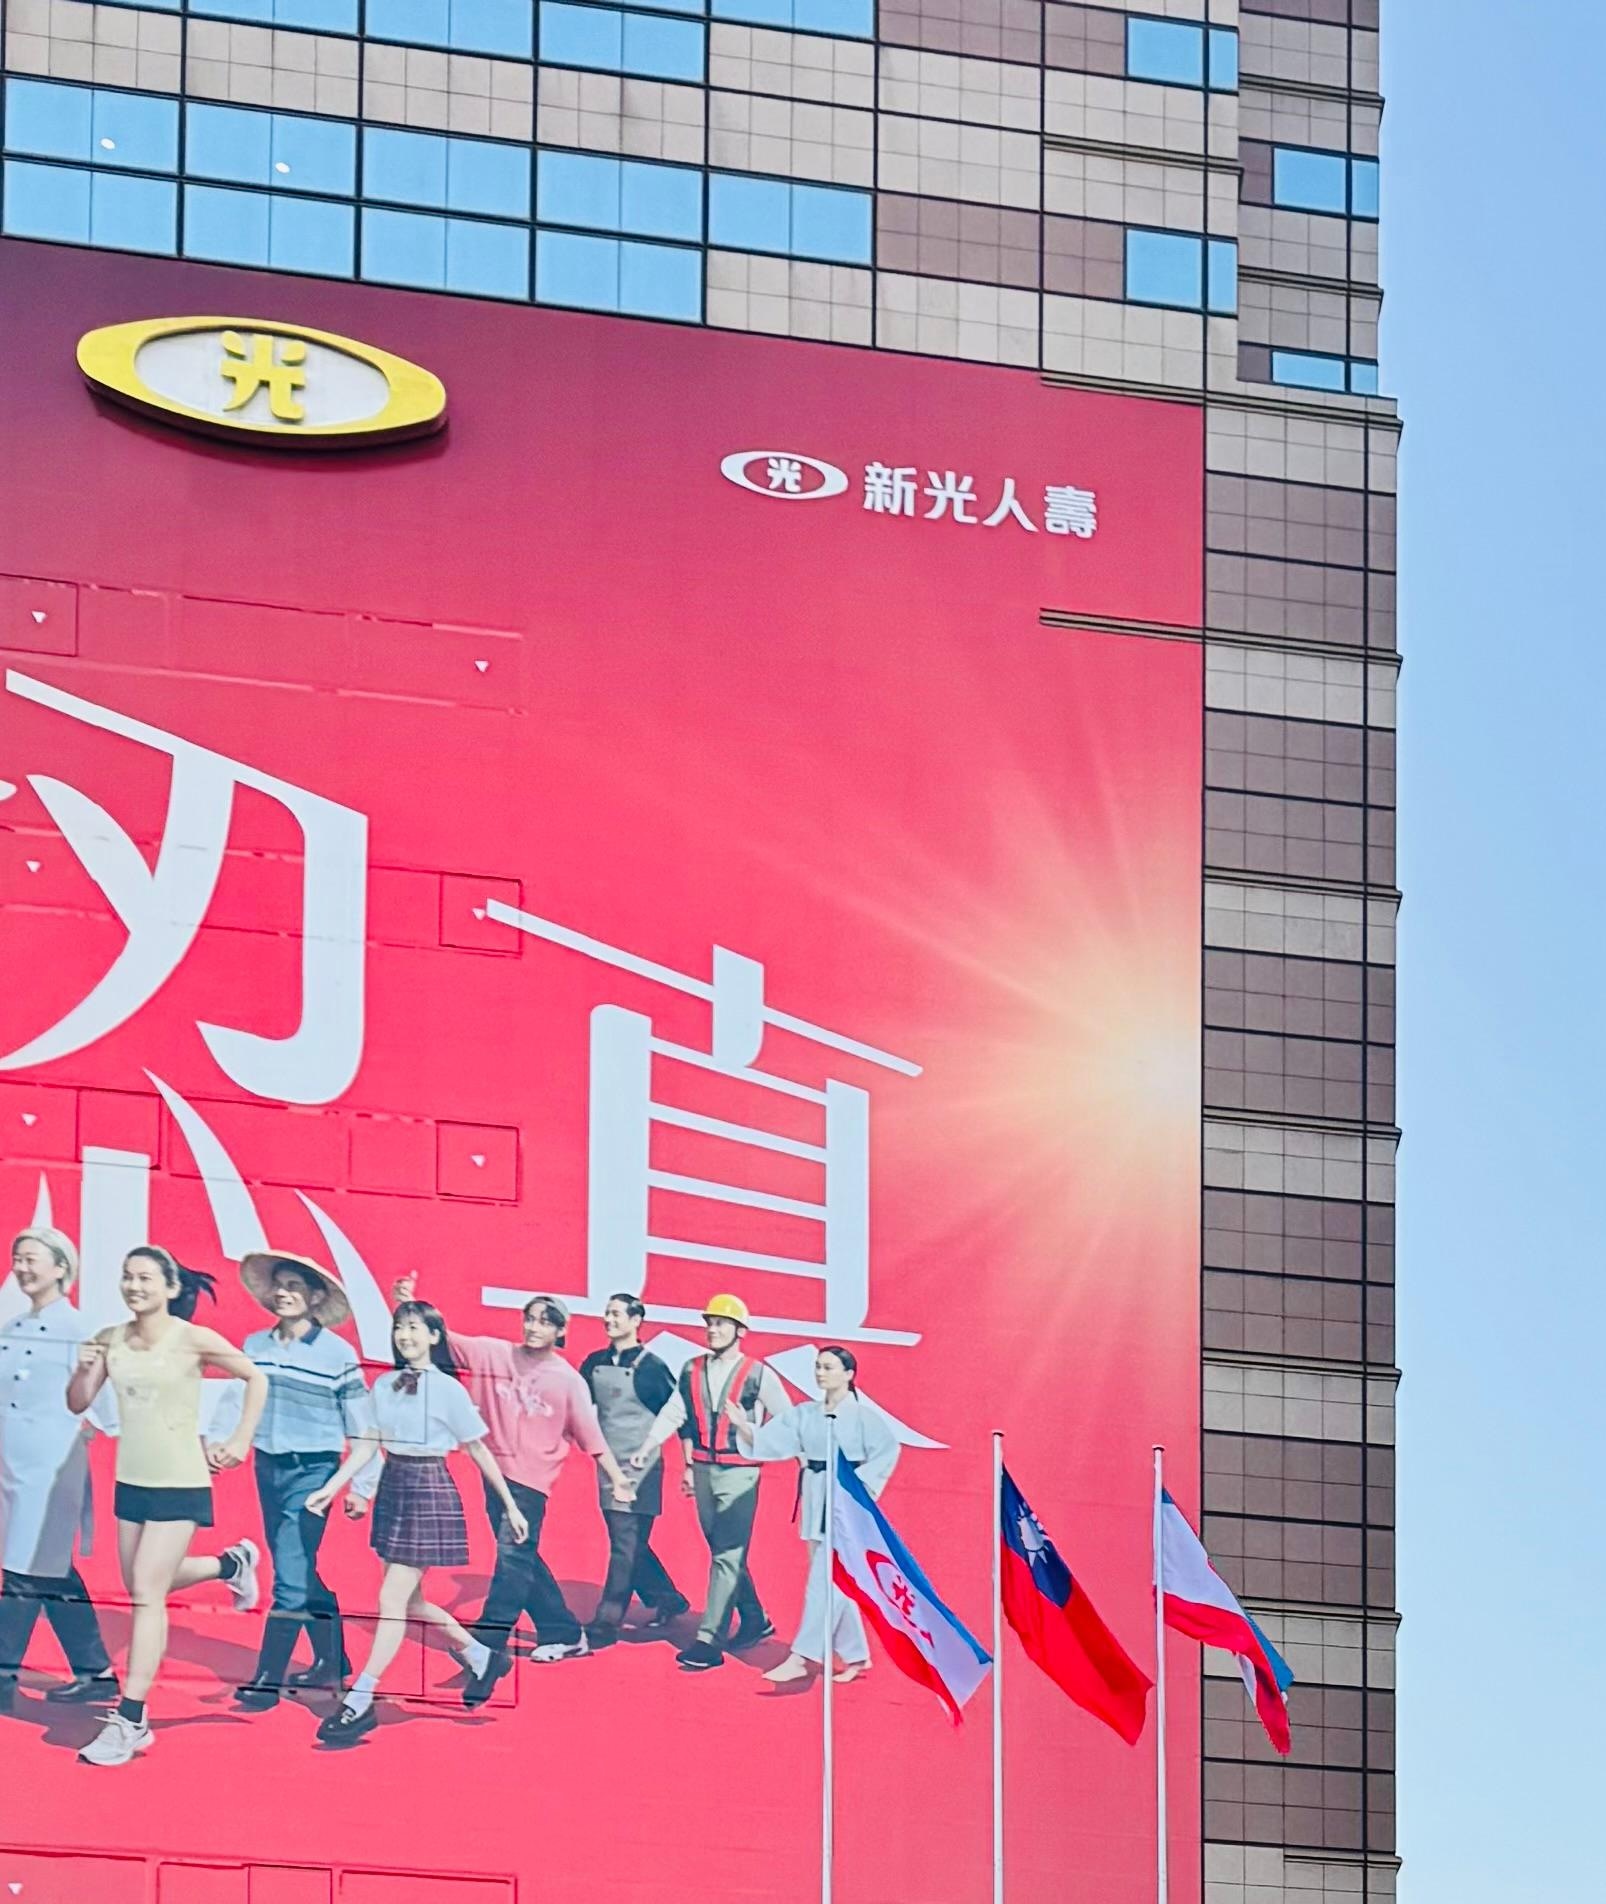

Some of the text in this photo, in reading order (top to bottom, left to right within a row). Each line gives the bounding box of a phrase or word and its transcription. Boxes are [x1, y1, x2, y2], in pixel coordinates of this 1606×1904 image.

[220, 330, 308, 424] 光
[861, 460, 1099, 541] 新光人壽
